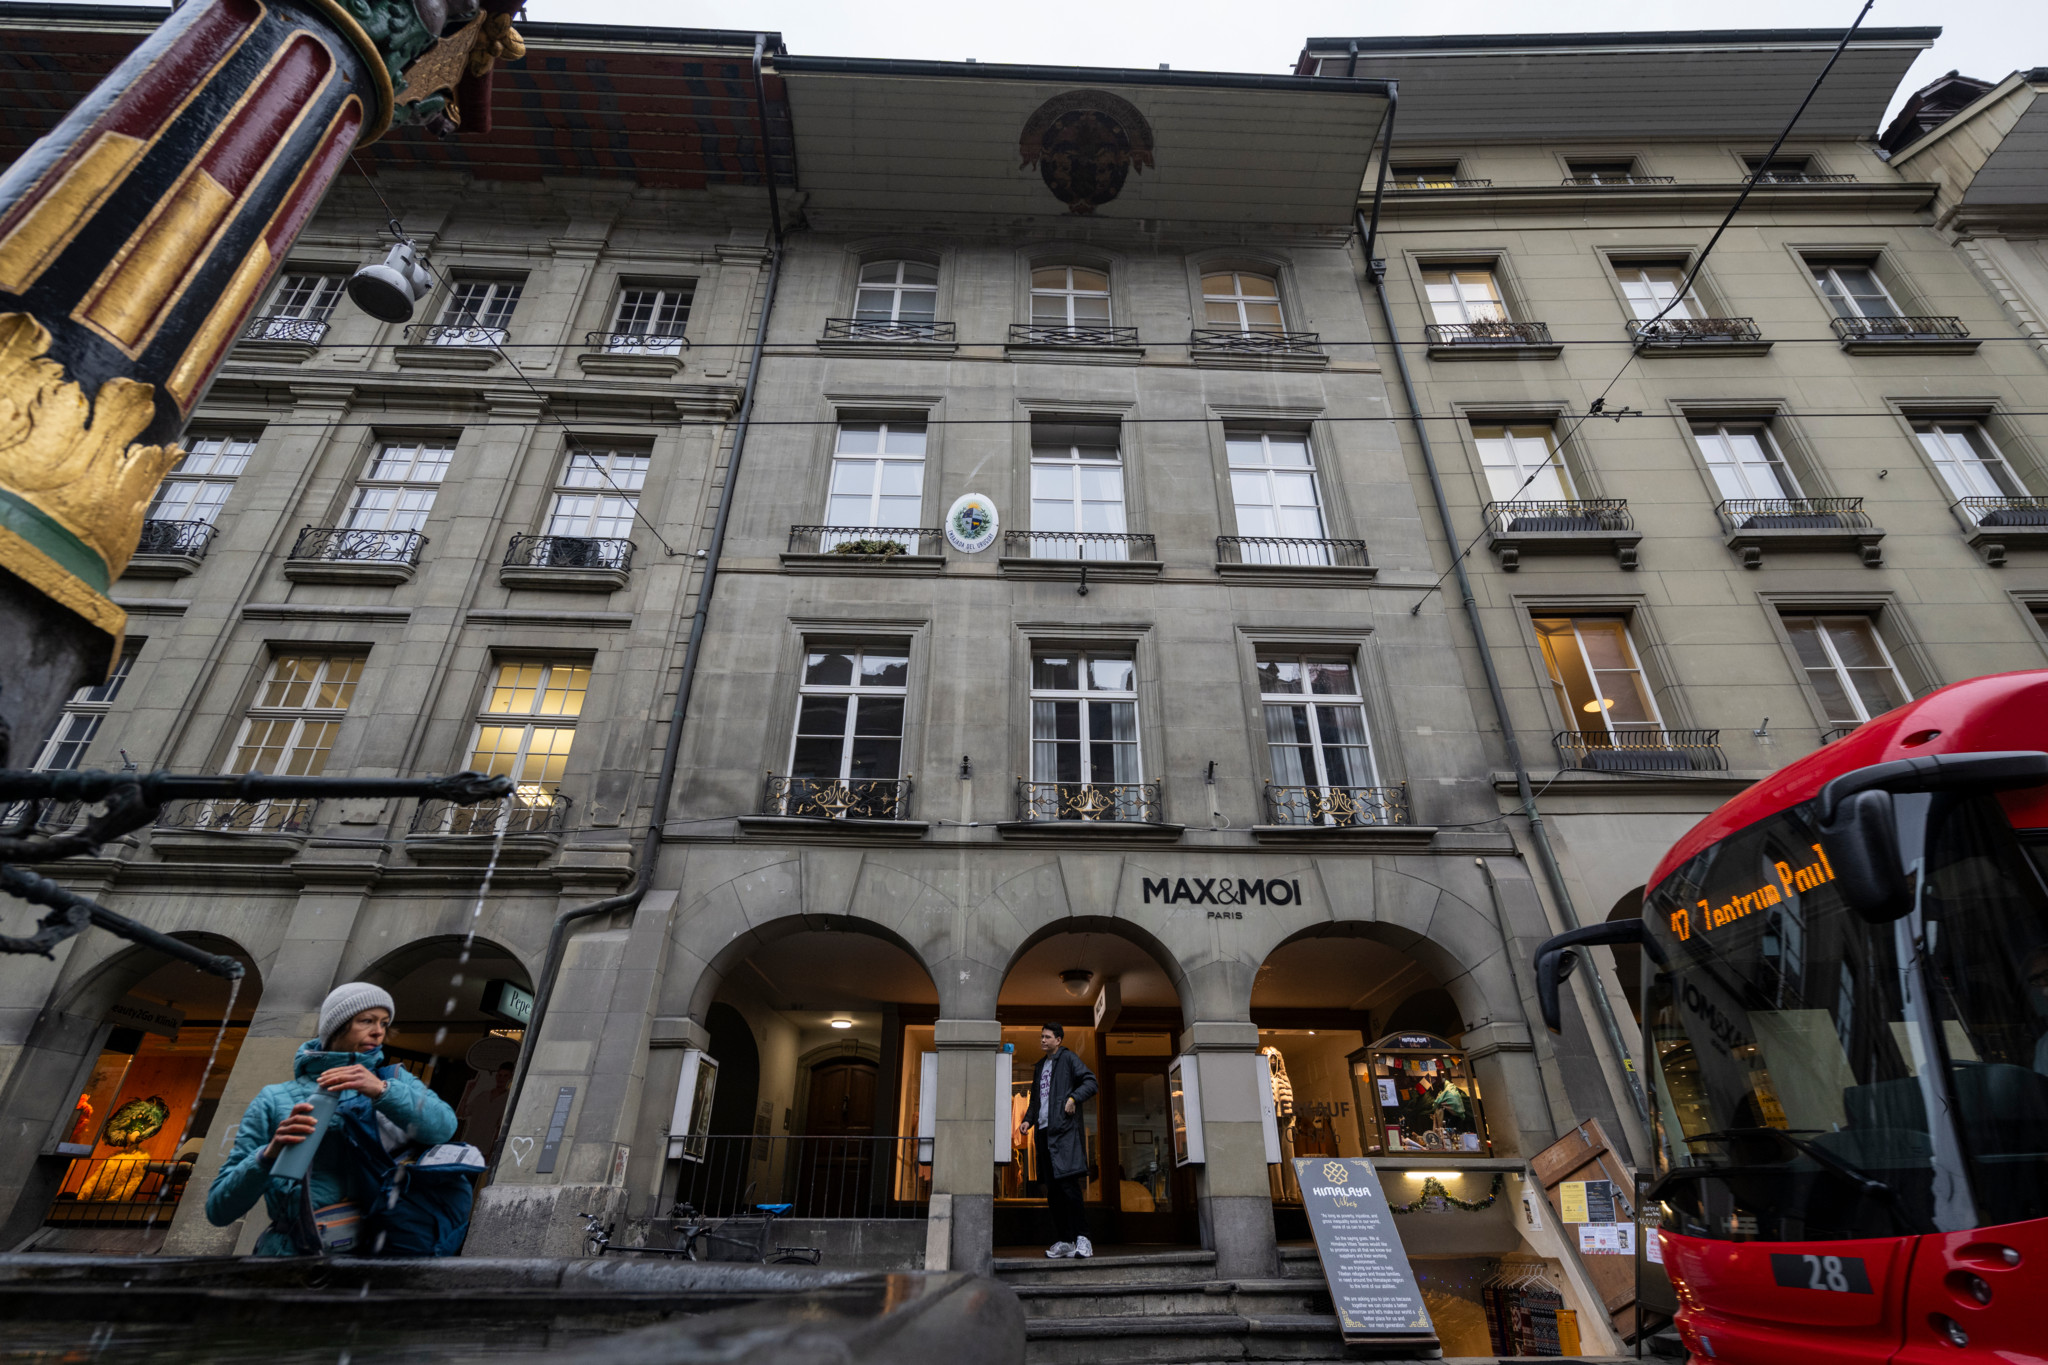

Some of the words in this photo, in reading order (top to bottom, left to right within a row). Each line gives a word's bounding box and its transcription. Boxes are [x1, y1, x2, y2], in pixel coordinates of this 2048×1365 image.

[948, 530, 965, 548] EMBAJADA
[977, 533, 994, 548] URUGUAY
[1142, 877, 1302, 906] MAX&MOI
[1207, 911, 1243, 920] PARIS
[510, 990, 531, 1016] Pepe
[111, 1004, 154, 1021] eauty2Go
[155, 1014, 178, 1028] Klinik
[1312, 1186, 1372, 1197] HIMALAYA
[1333, 1196, 1358, 1208] Vibes
[1803, 1254, 1848, 1292] 28
